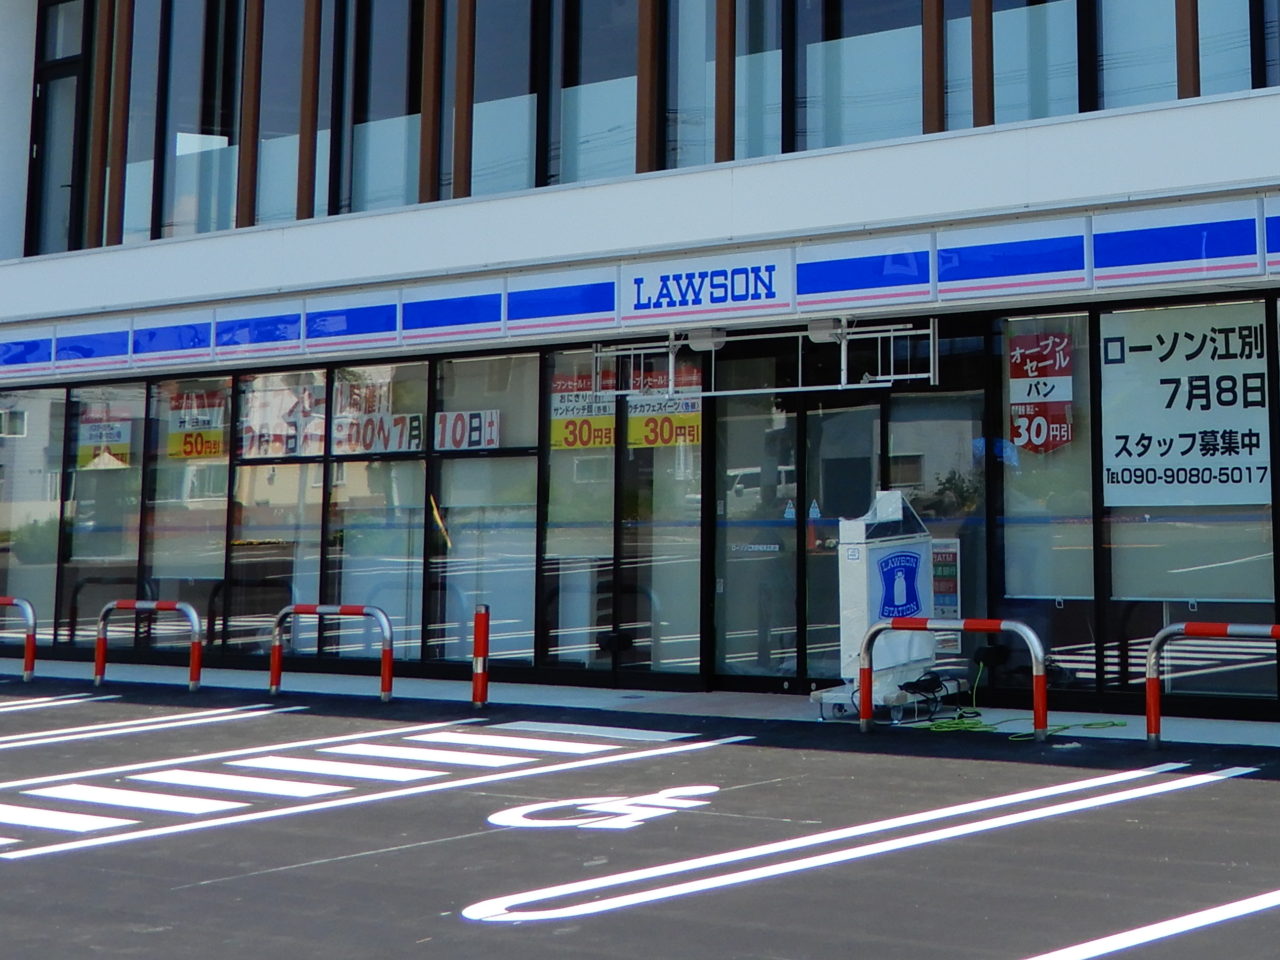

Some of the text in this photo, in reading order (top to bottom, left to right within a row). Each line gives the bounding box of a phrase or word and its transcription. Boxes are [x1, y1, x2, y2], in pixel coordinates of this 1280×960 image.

[633, 264, 776, 310] LAWSON
[1010, 335, 1068, 363] オープン
[1023, 351, 1070, 377] セール
[1027, 380, 1056, 398] パン
[1114, 428, 1261, 458] スタッフ募集中
[882, 556, 917, 572] LAWSON
[882, 601, 918, 617] STATION
